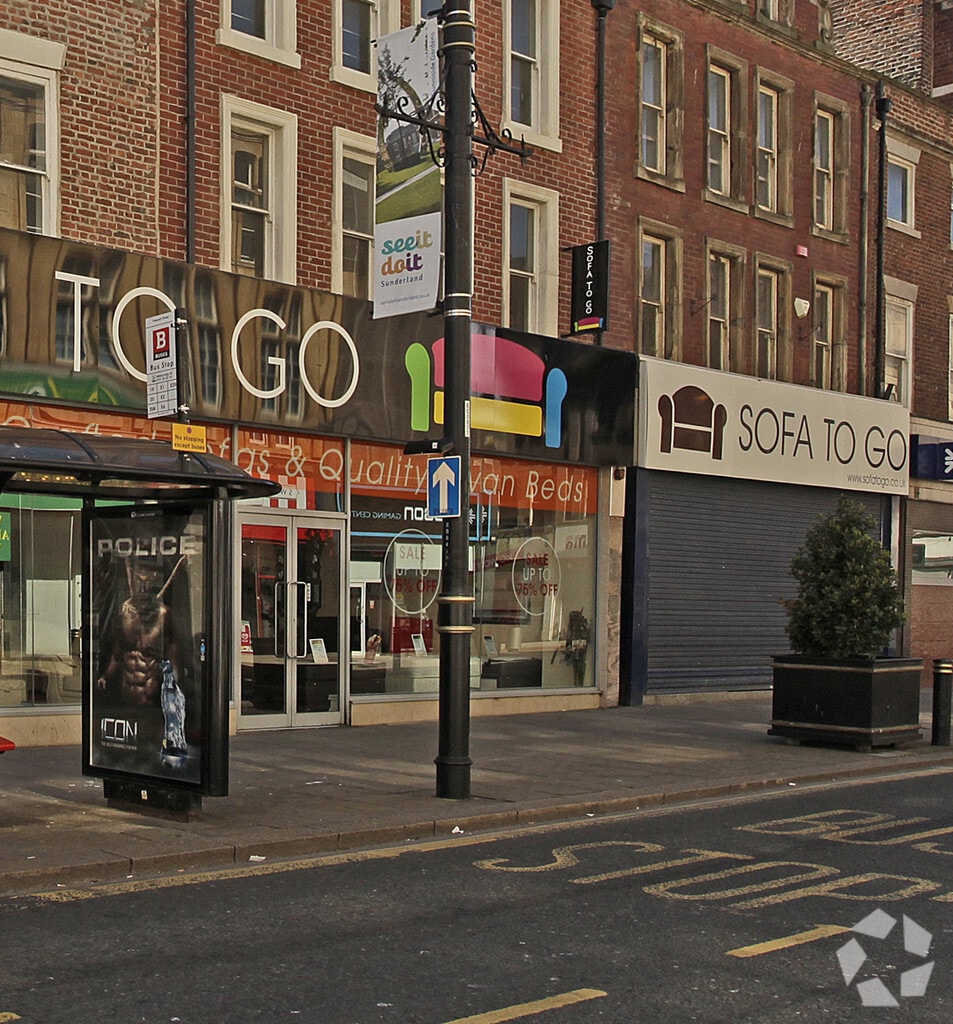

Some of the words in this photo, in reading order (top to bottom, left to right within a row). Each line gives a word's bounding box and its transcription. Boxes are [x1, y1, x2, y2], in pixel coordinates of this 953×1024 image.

[586, 246, 594, 278] SOFA
[380, 275, 423, 287] Sunderland
[586, 281, 593, 297] TO
[585, 300, 592, 314] GO
[54, 271, 176, 382] TO
[230, 309, 360, 407] GO
[156, 331, 166, 349] B
[161, 361, 174, 369] Stop
[738, 404, 813, 459] SOFA
[823, 418, 856, 465] TO
[865, 426, 907, 471] GO
[285, 445, 307, 478] &
[319, 448, 429, 495] Quality
[525, 470, 583, 503] Beds
[847, 474, 906, 488] www.sofatogo.co.uk
[97, 536, 198, 557] POLICE
[400, 545, 425, 560] SALE
[526, 553, 549, 566] SALE
[523, 567, 536, 581] UP
[538, 568, 551, 581] TO
[389, 578, 414, 593] 75%
[416, 579, 438, 593] OFF
[516, 583, 538, 597] 75%
[540, 584, 559, 597] OFF
[101, 717, 137, 741] ICON
[733, 809, 953, 857] BU
